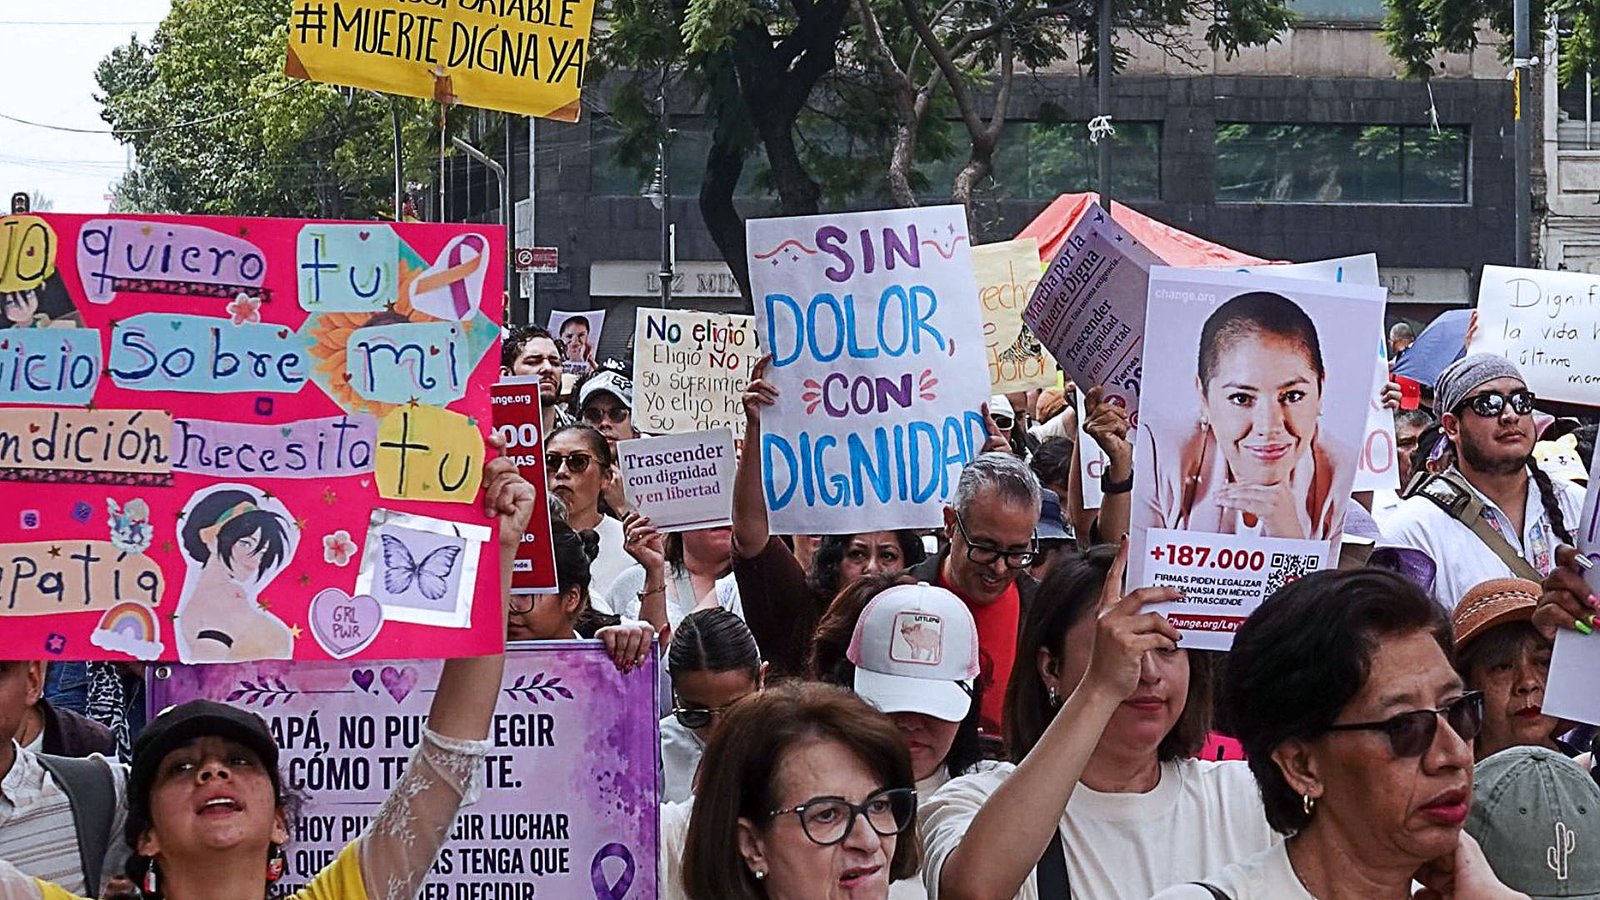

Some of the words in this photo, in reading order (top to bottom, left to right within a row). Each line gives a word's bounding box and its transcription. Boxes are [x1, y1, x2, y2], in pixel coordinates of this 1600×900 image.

[295, 3, 443, 64] #MUERTE
[448, 21, 539, 80] DIGNA
[546, 36, 584, 88] YA
[82, 225, 264, 294] quiero
[301, 238, 381, 302] tu
[816, 224, 920, 282] SIN
[1026, 275, 1058, 325] Marcha
[1054, 248, 1074, 281] por
[1068, 235, 1086, 252] la
[1038, 291, 1069, 340] Muerte
[1063, 250, 1100, 295] Digna
[1155, 289, 1216, 304] change.org
[647, 315, 681, 343] No
[766, 285, 955, 367] DOLOR,
[1065, 300, 1112, 362] Trascender
[1503, 317, 1521, 339] la
[1542, 322, 1578, 339] vida
[1077, 357, 1090, 372] con
[1087, 315, 1119, 358] dignidad
[1098, 324, 1132, 363] libertad
[0, 346, 93, 391] icio
[358, 328, 458, 392] mi
[708, 353, 739, 369] NO
[1091, 361, 1103, 375] en
[1110, 357, 1140, 387] Viernes
[1087, 371, 1096, 383] y
[823, 373, 913, 417] CON
[492, 423, 538, 448] 00
[380, 412, 470, 495] tu
[624, 443, 724, 470] Trascender
[763, 411, 988, 511] DIGNIDAD
[628, 474, 653, 486] con
[655, 463, 717, 485] dignidad
[635, 494, 643, 506] y
[646, 492, 663, 502] en
[667, 481, 721, 500] libertad
[1150, 544, 1265, 571] +187.000
[1154, 573, 1188, 583] FIRMAS
[1190, 577, 1215, 585] PIDEN
[1217, 579, 1262, 587] LEGALIZAR
[333, 605, 358, 623] GRL
[333, 623, 361, 638] PWR
[339, 716, 374, 749] NO
[385, 716, 428, 749] PU
[289, 751, 370, 790] CÓMO
[295, 816, 336, 842] HOY
[490, 814, 569, 840] LUCHAR
[459, 848, 524, 874] TENGA
[530, 848, 569, 876] QUE
[456, 882, 534, 900] DECIDIR
